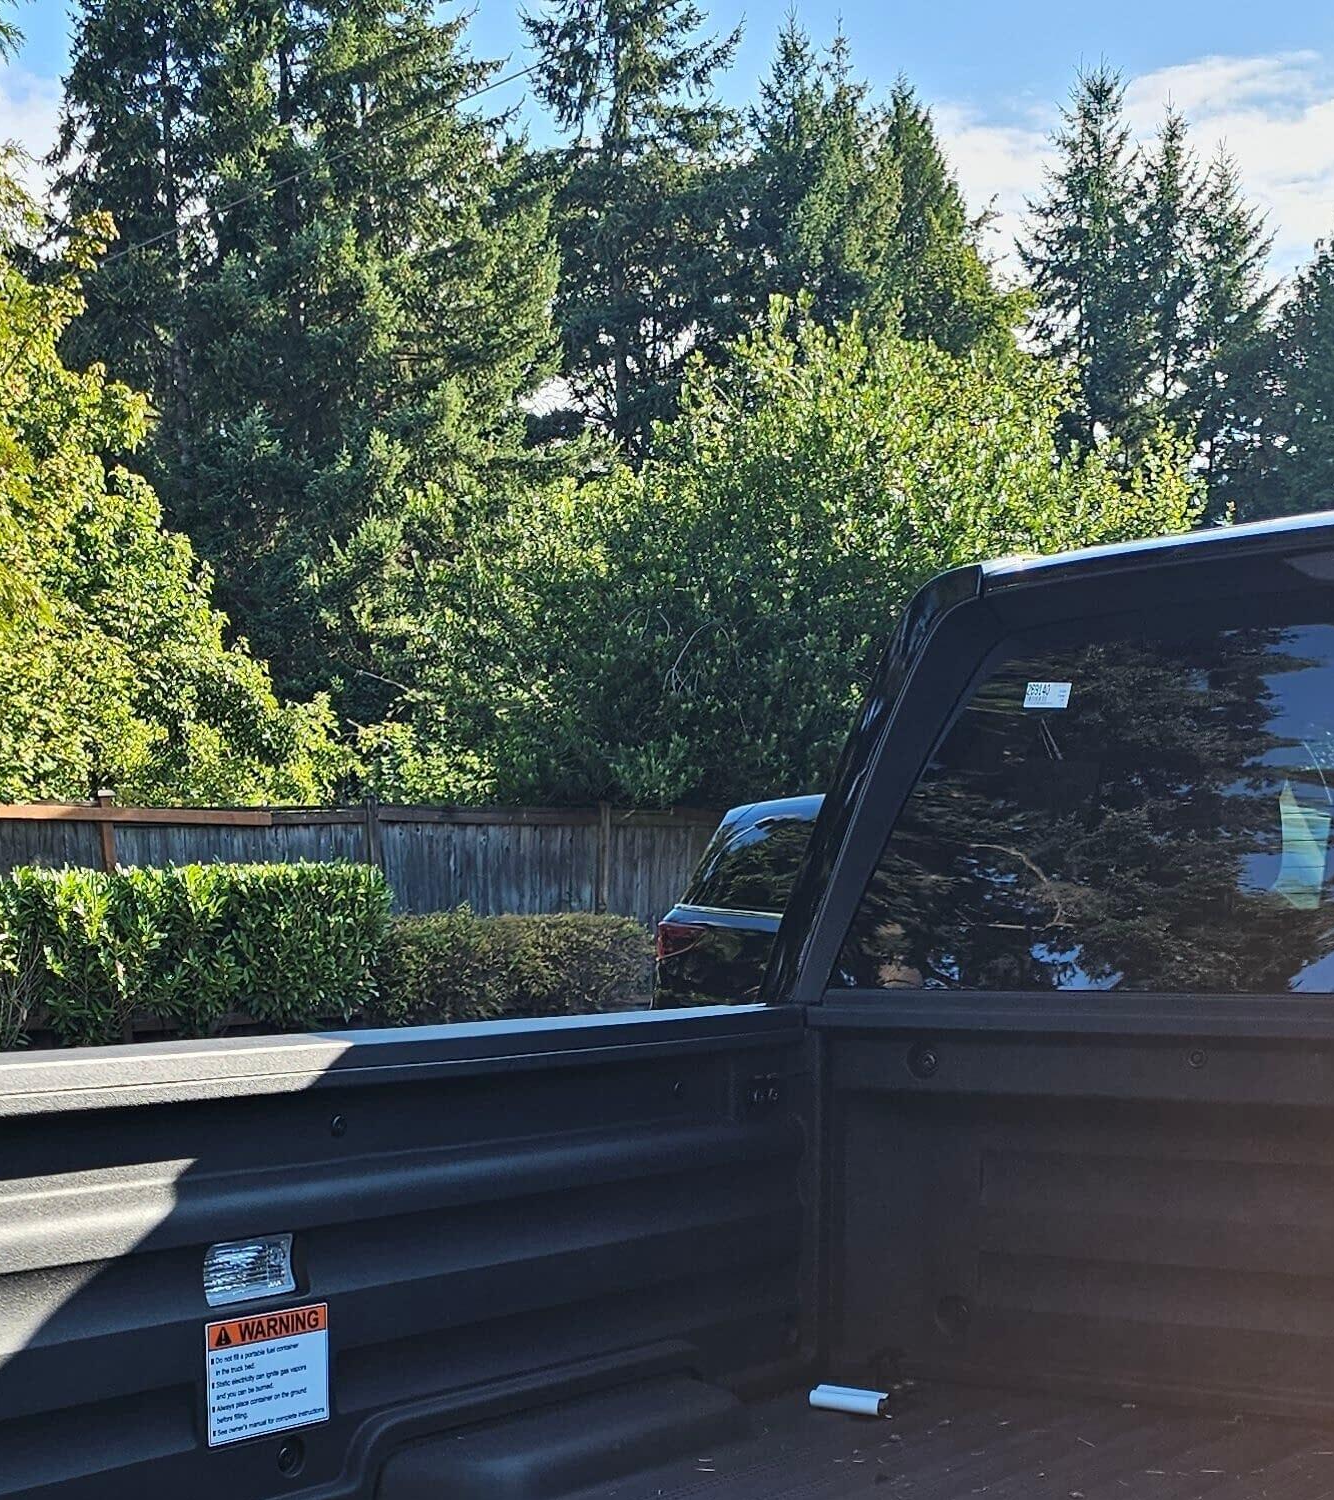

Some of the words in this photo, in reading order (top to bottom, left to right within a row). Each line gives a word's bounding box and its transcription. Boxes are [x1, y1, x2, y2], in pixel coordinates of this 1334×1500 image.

[238, 1310, 319, 1342] WARNING
[244, 1350, 265, 1360] portable
[276, 1342, 299, 1352] container
[216, 1380, 231, 1388] Static
[231, 1375, 255, 1386] electricity
[266, 1369, 279, 1379] ignite
[280, 1368, 289, 1376] gas
[290, 1364, 307, 1373] vapors
[230, 1365, 244, 1374] truck
[216, 1391, 226, 1401] and
[226, 1391, 237, 1400] you
[217, 1403, 234, 1412] Always
[235, 1400, 249, 1409] place
[249, 1395, 272, 1405] container
[290, 1386, 307, 1397] ground
[216, 1416, 233, 1425] before
[217, 1429, 227, 1437] See
[228, 1424, 247, 1434] owner's
[248, 1419, 266, 1428] manual
[267, 1417, 275, 1425] for
[275, 1413, 297, 1423] complete
